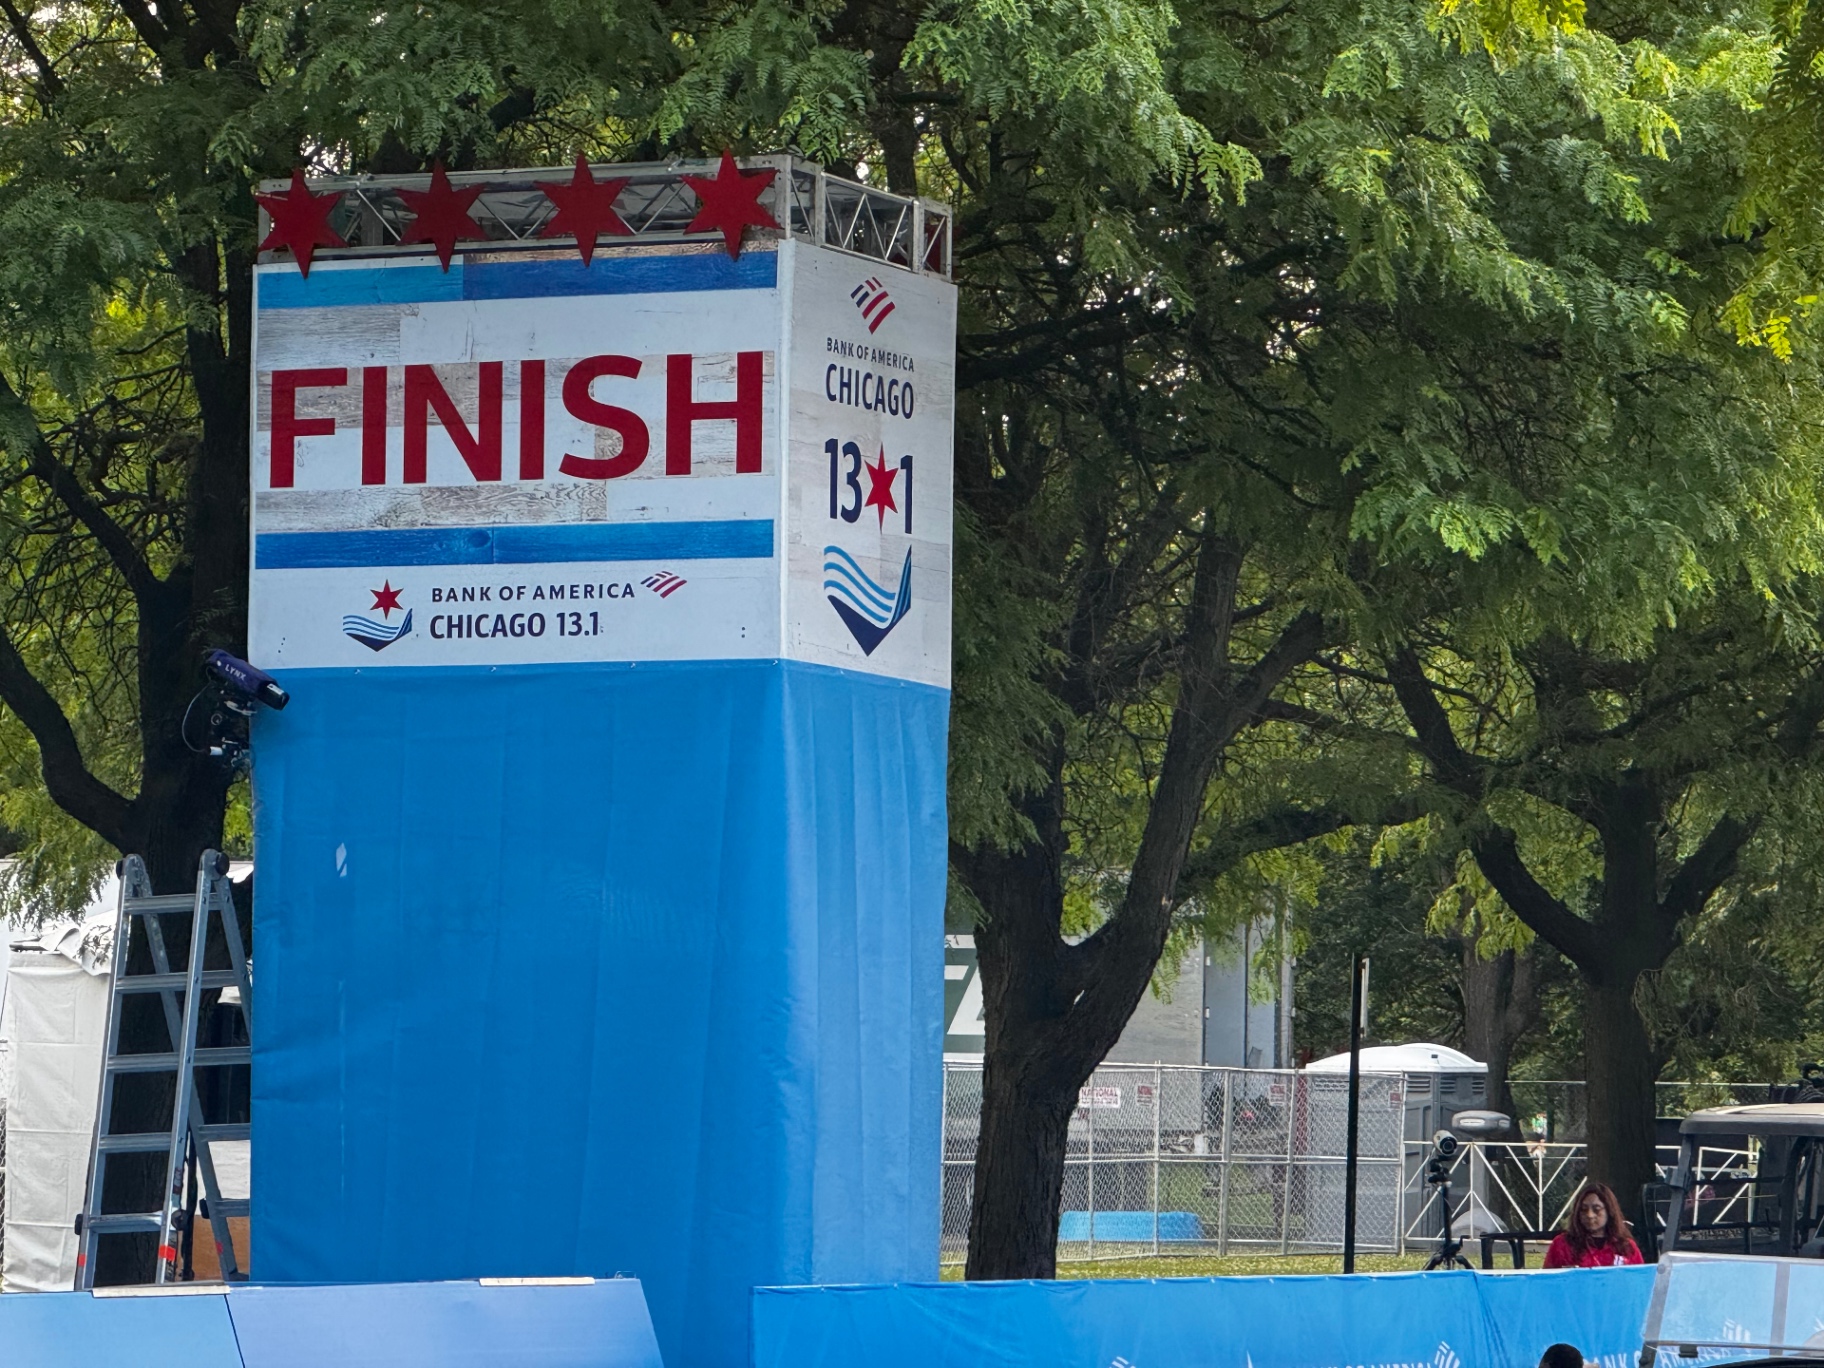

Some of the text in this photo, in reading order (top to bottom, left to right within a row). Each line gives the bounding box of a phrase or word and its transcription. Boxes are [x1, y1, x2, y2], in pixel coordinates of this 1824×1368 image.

[826, 337, 915, 373] BANK OF AMERICA
[825, 363, 915, 420] CHICAGO
[269, 350, 763, 488] FINISH
[431, 582, 636, 603] BANK OF AMERICA
[429, 611, 599, 639] CHICAGO 13.1
[225, 663, 247, 681] LYNX
